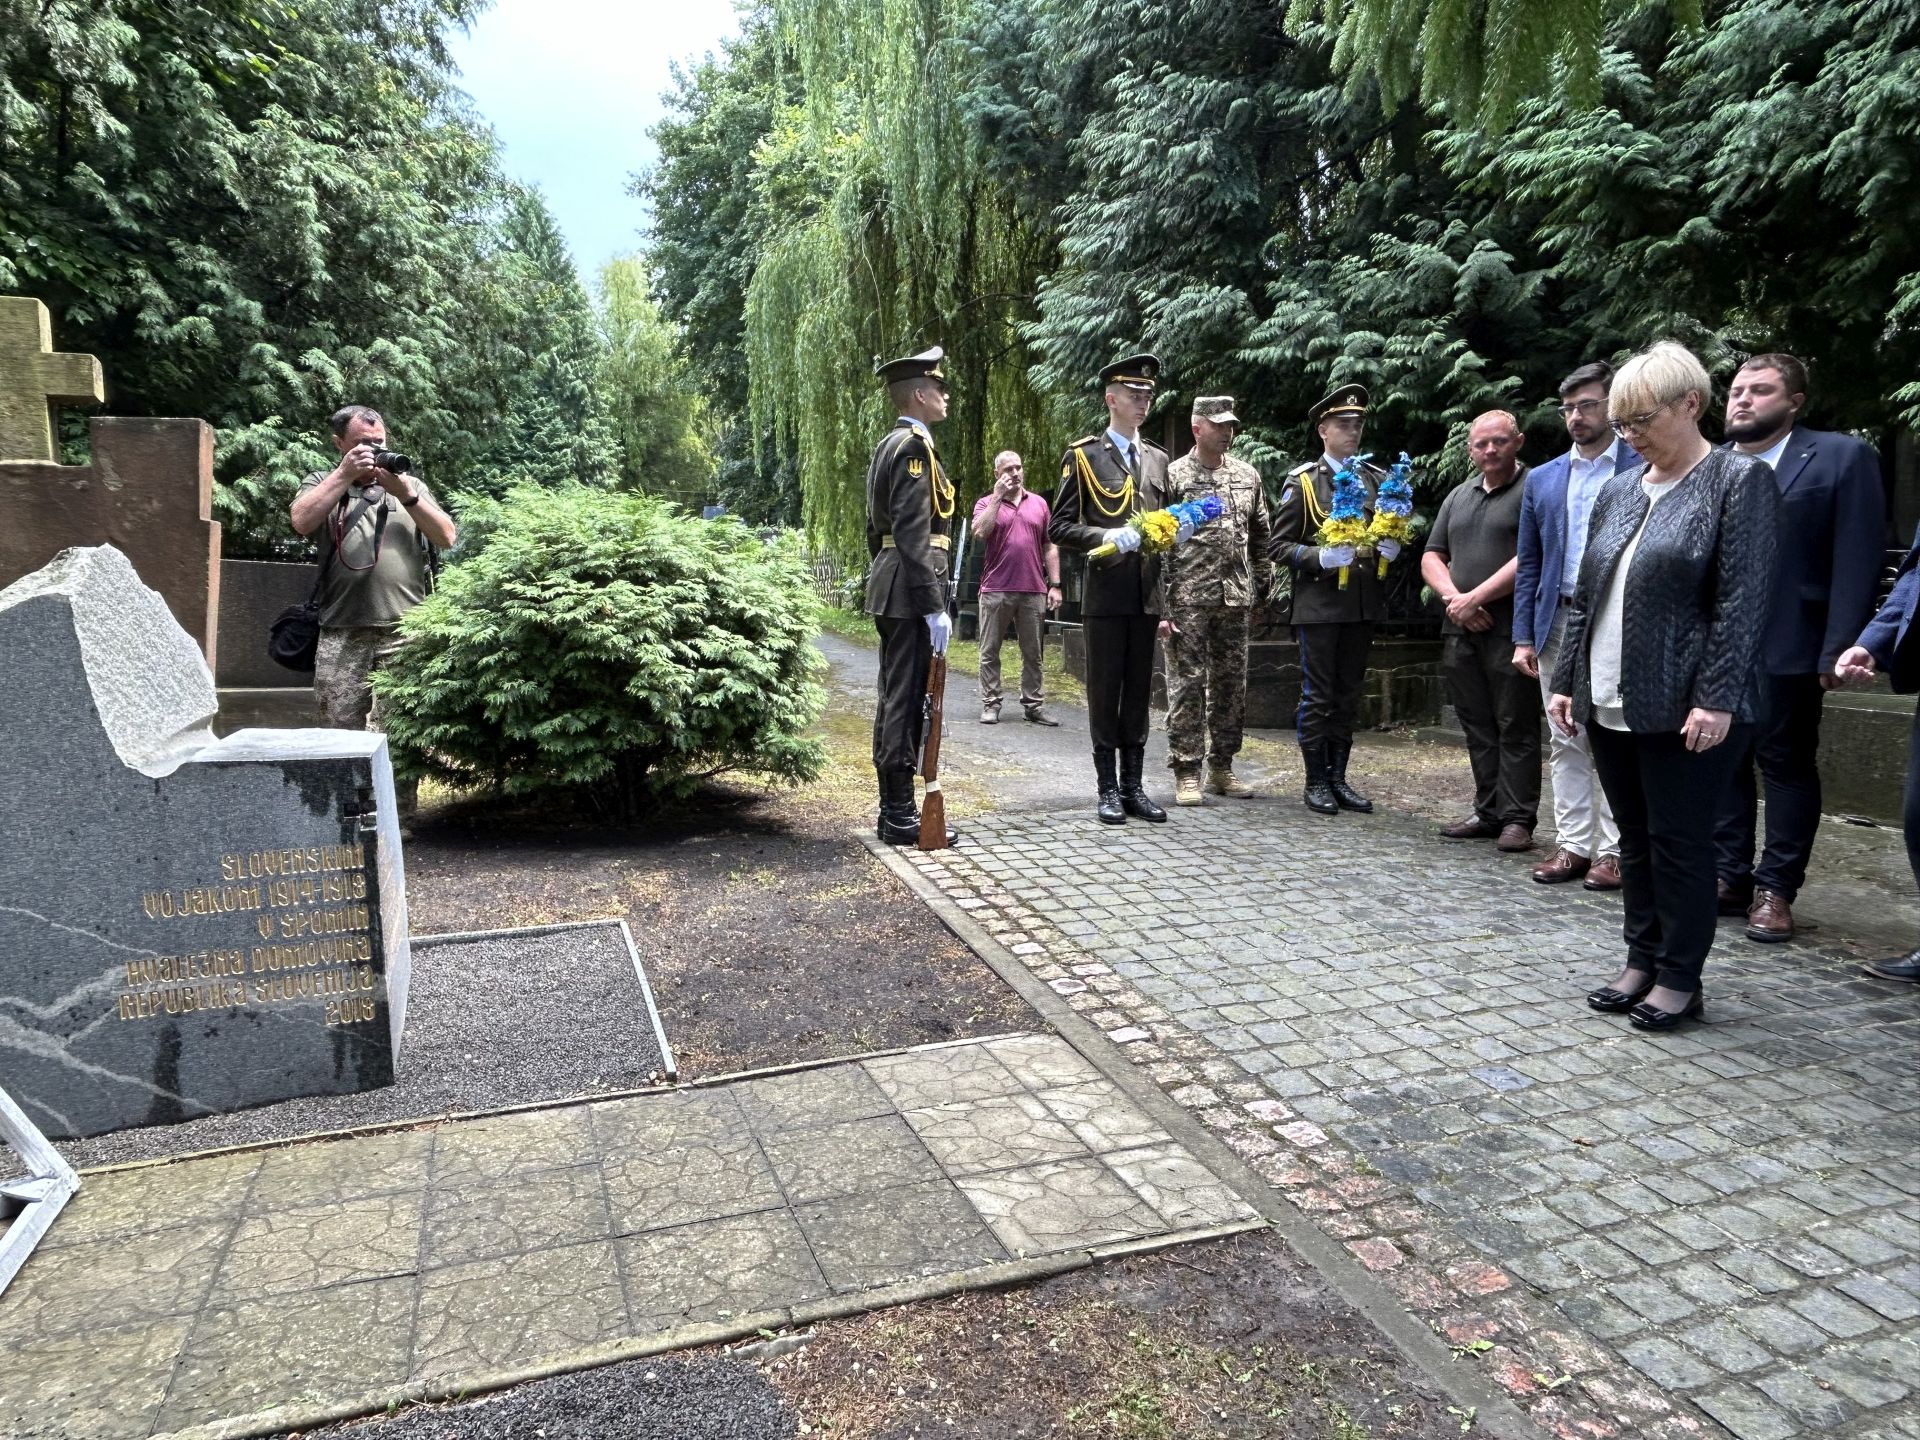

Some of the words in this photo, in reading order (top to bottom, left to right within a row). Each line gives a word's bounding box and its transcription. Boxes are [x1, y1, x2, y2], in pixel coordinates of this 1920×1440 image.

[221, 844, 365, 881] SLOVENSKIM
[257, 914, 273, 939] V
[281, 903, 369, 938] SPOMIN
[325, 996, 375, 1025] 2018
